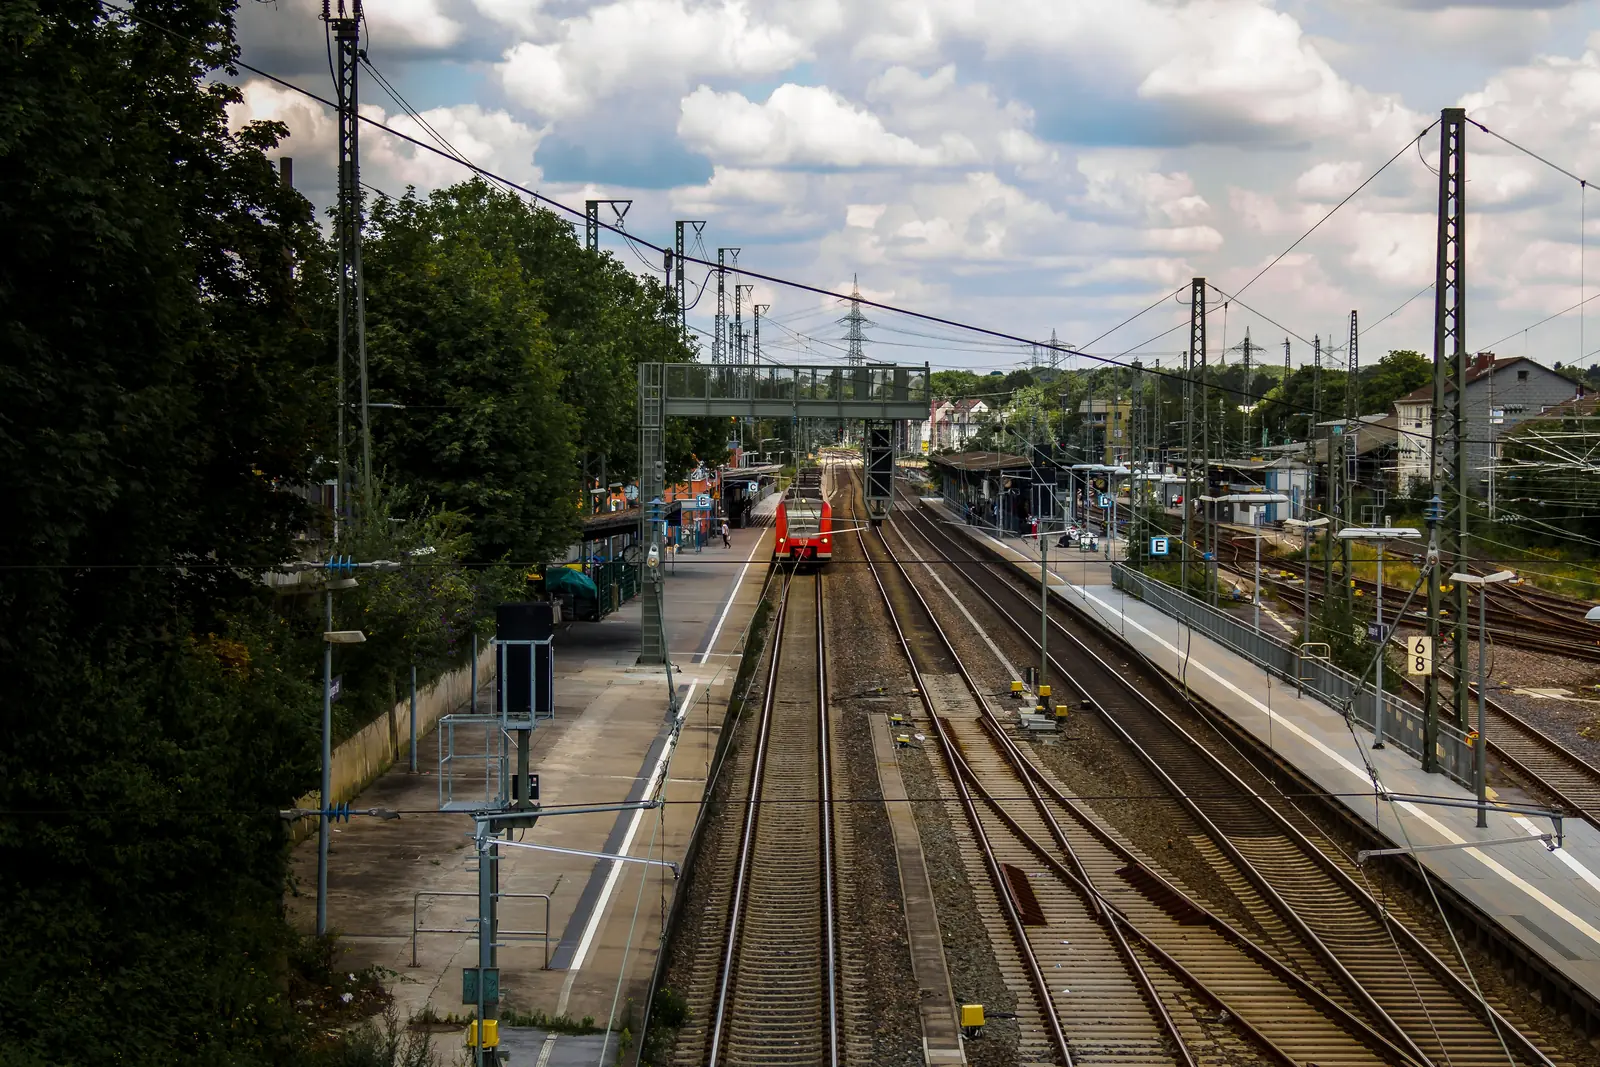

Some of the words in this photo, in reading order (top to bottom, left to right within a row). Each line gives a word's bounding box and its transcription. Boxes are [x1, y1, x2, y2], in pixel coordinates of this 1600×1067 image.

[750, 483, 757, 491] C
[1155, 540, 1164, 552] E
[1415, 638, 1425, 654] 6
[1415, 656, 1425, 671] 8
